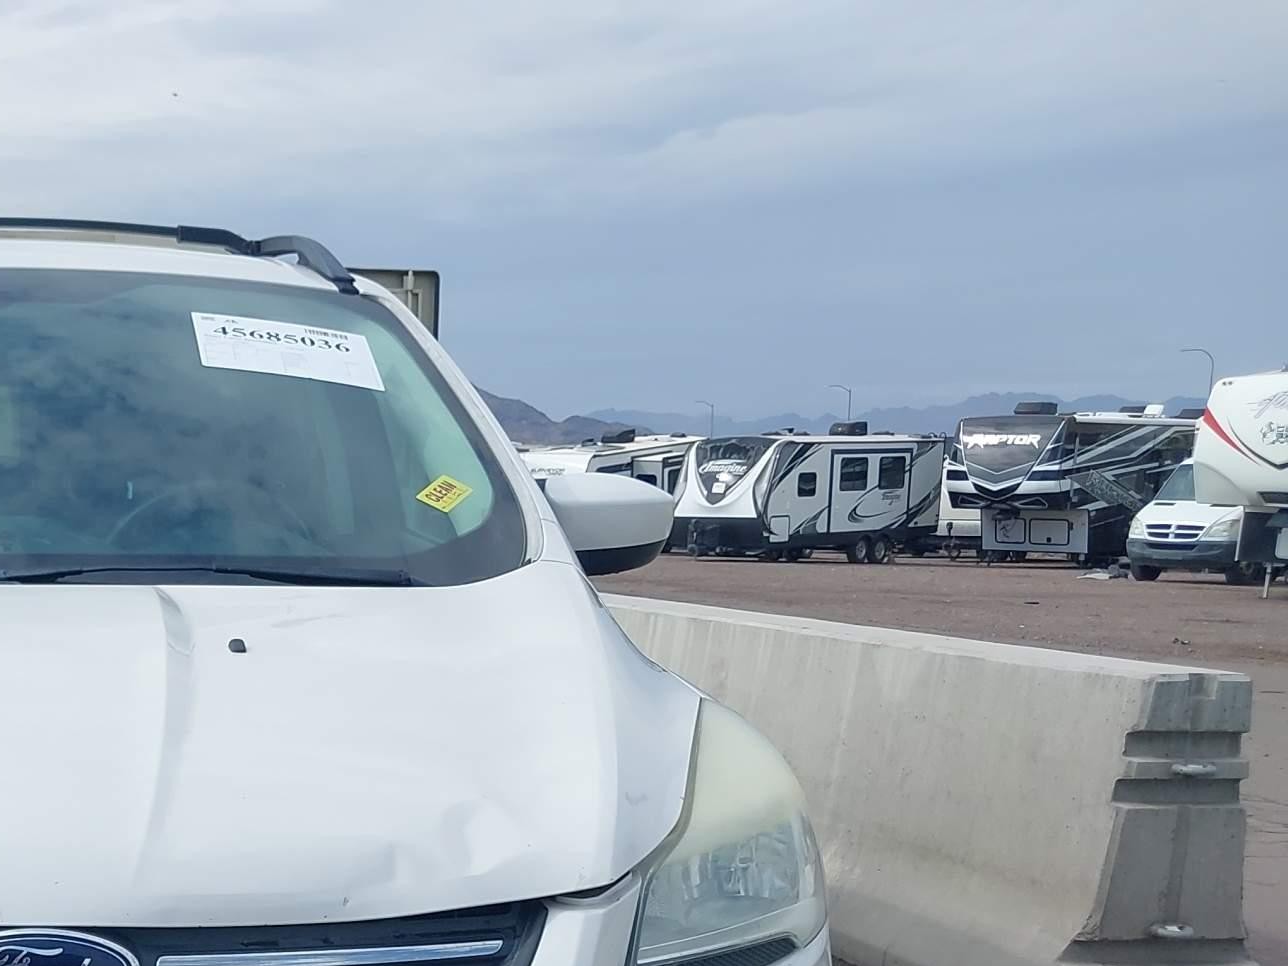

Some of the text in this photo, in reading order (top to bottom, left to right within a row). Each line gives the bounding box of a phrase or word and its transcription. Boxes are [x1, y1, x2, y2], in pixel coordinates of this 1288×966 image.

[213, 325, 351, 353] 45685036
[961, 433, 1042, 450] RAPTOR
[424, 479, 457, 503] CLEAN
